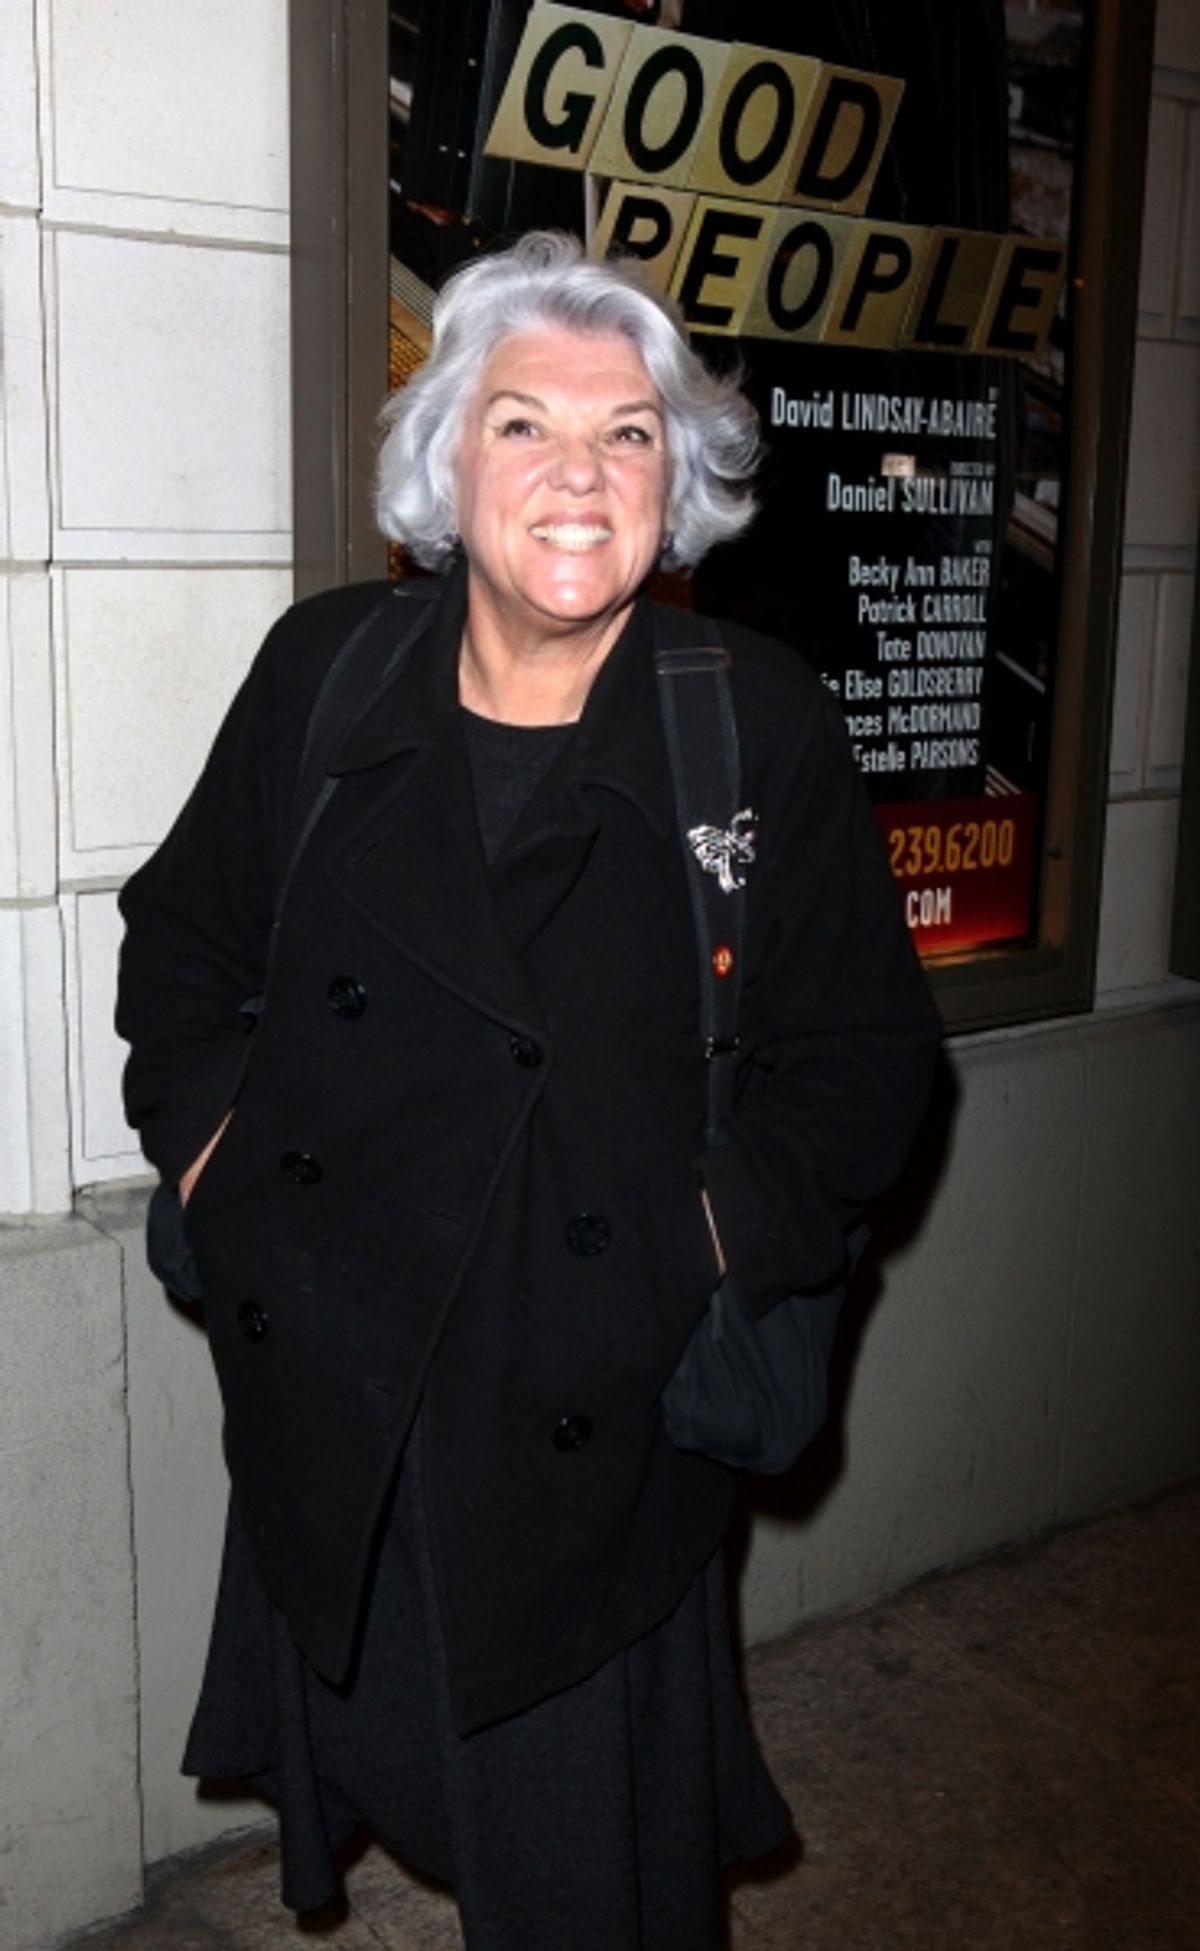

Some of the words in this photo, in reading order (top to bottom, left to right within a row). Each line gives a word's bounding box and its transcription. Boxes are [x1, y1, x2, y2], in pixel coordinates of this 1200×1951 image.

[523, 22, 881, 200] GOOD
[608, 190, 1061, 350] PEOPLE
[772, 386, 833, 428] David
[842, 393, 997, 439] LINDSAY-ABAIRE
[827, 473, 895, 512] Daniel
[901, 478, 993, 515] SULLIVAN
[849, 555, 899, 593] Becky
[904, 556, 935, 586] Ann
[940, 556, 990, 587] BAKER
[858, 594, 916, 624] Patrick
[922, 595, 987, 623] CARROLL
[876, 630, 911, 661] Tate
[916, 631, 986, 660] DONOVAN
[845, 669, 882, 700] Elise
[887, 667, 984, 697] GOLDSBERRY
[887, 703, 981, 735] McDORMAND
[910, 739, 980, 769] PARSONS
